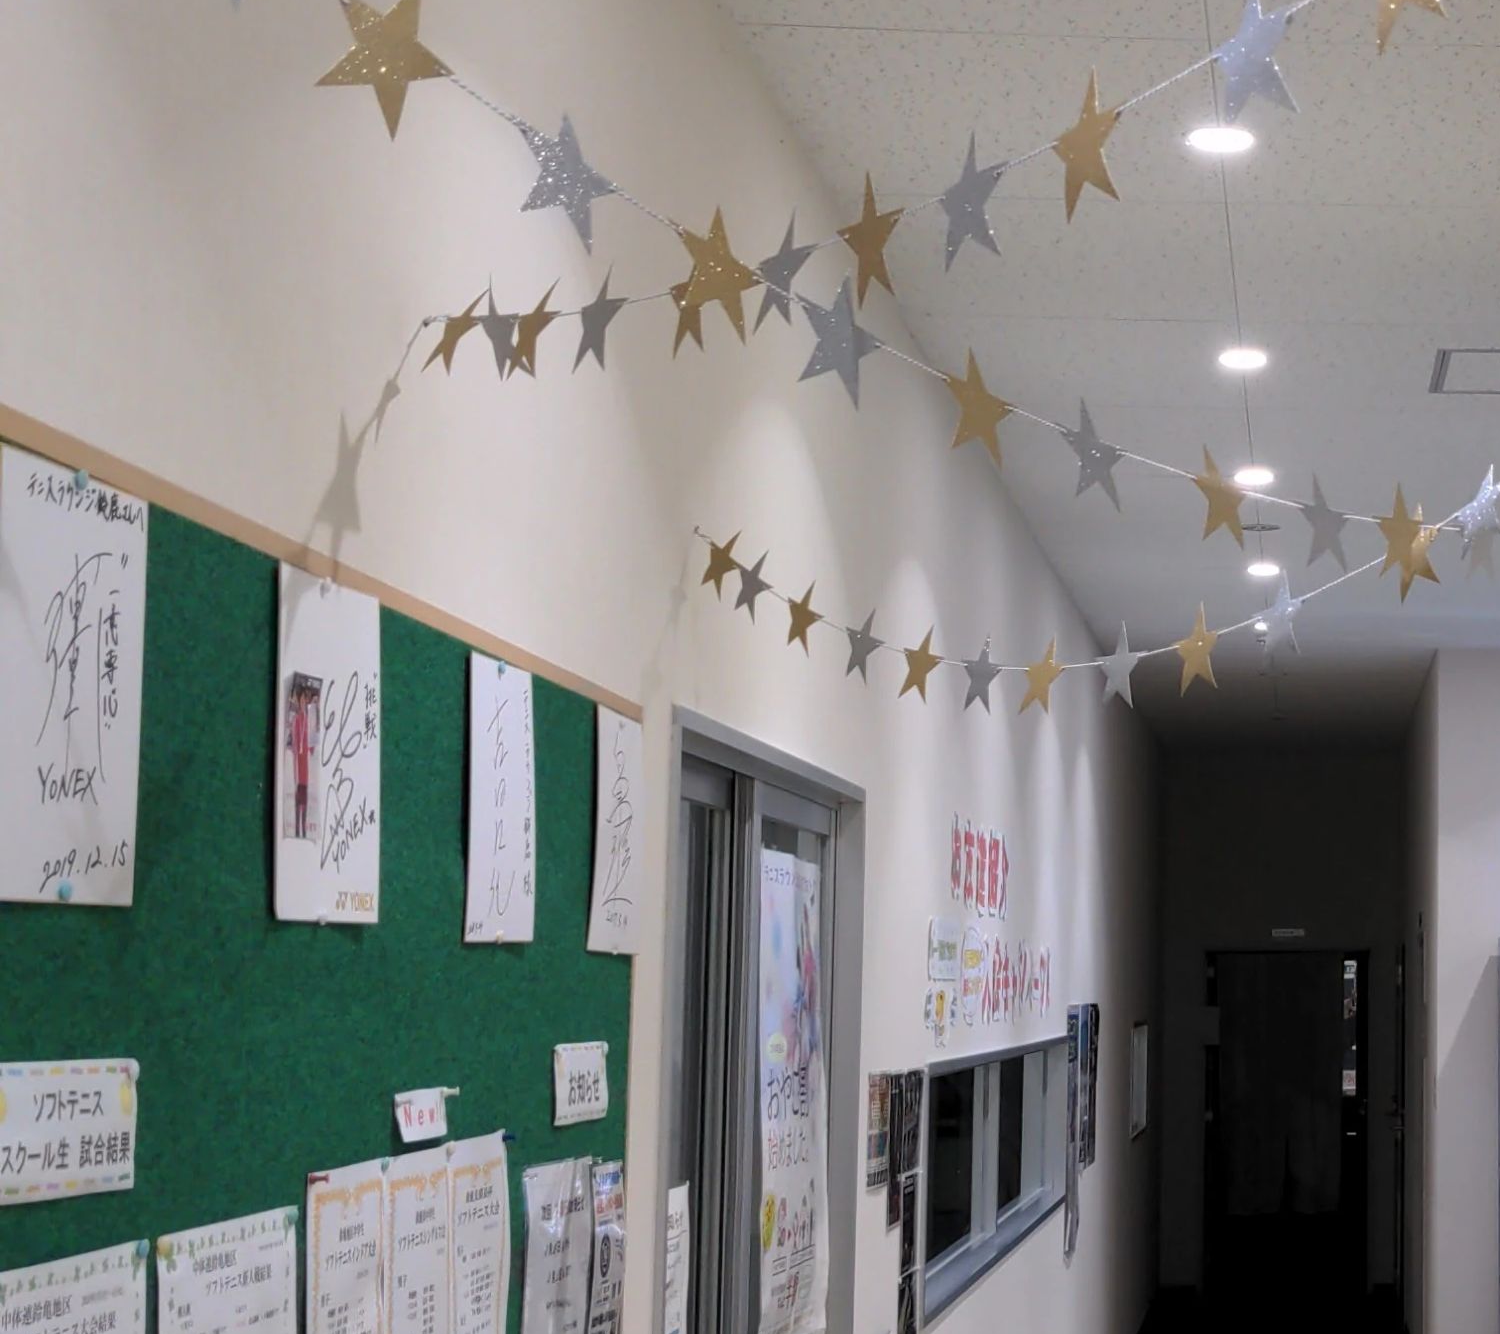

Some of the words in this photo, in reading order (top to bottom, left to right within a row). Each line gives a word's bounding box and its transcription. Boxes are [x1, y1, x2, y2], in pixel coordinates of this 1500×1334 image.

[38, 763, 98, 806] YONEX
[34, 1090, 104, 1122] ソフトテニス
[568, 1070, 600, 1106] お知らせ
[1, 1137, 70, 1174] スクール生
[80, 1132, 130, 1168] 試合結果
